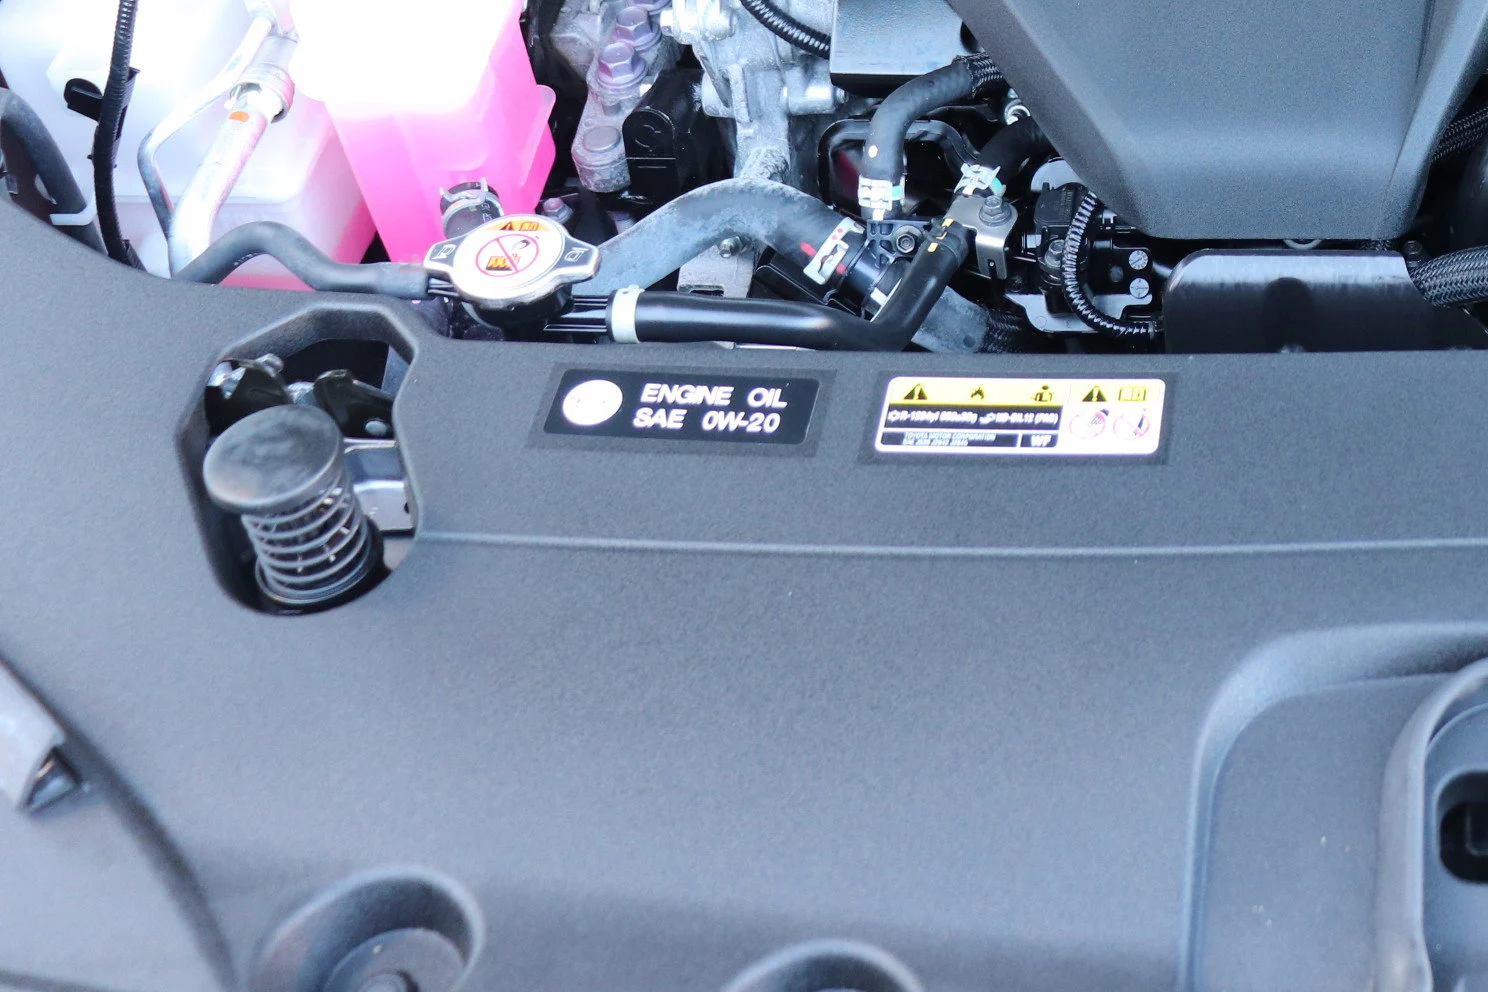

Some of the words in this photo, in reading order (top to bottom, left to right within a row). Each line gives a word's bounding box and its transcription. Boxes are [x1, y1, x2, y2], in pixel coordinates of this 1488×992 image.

[640, 383, 735, 406] ENGINE
[747, 387, 788, 408] OIL
[633, 408, 688, 429] SAE
[701, 411, 781, 433] 0W-20
[905, 431, 928, 439] TOYOTA
[952, 432, 997, 441] CORPORATION
